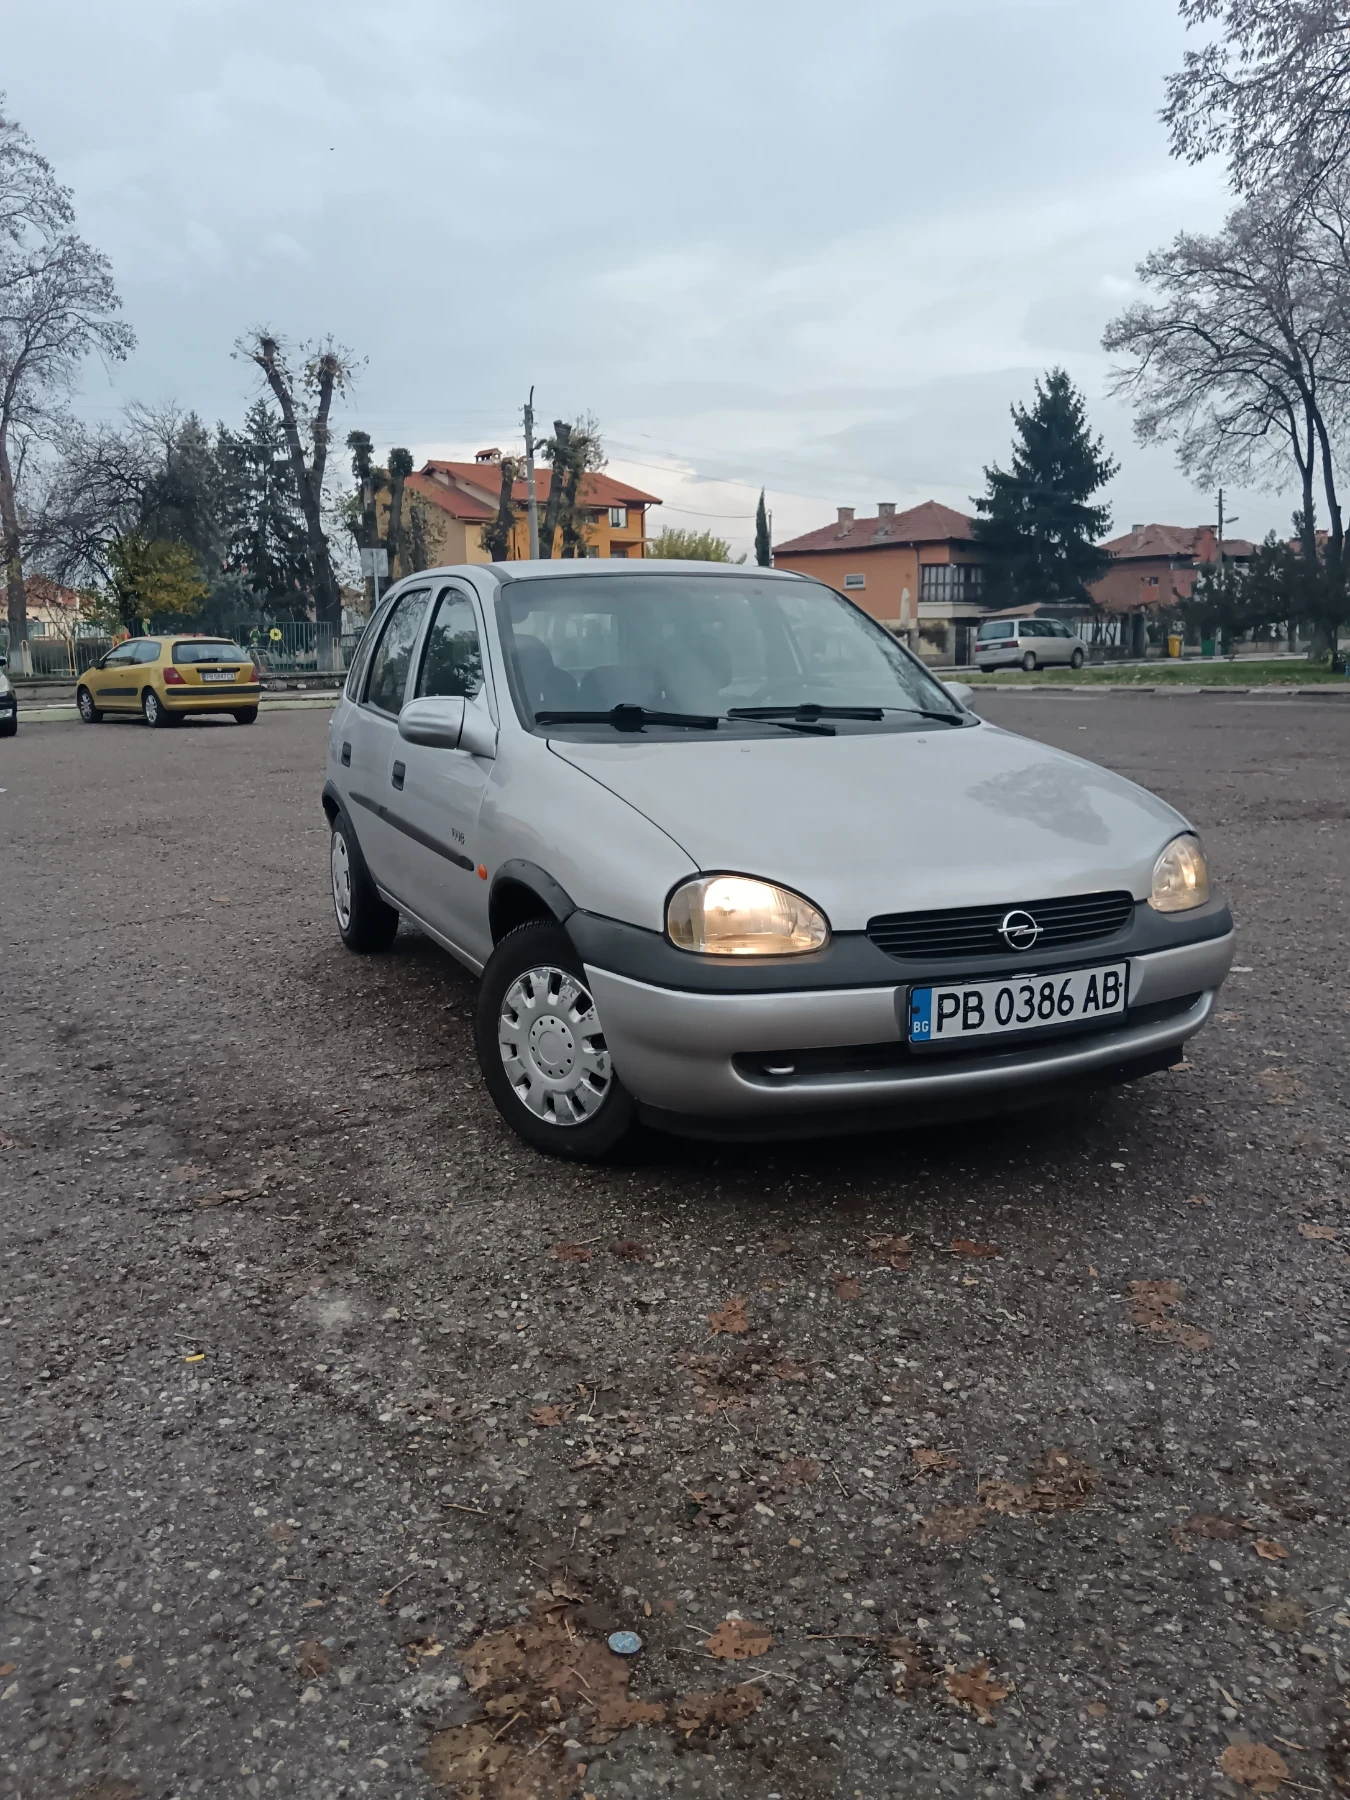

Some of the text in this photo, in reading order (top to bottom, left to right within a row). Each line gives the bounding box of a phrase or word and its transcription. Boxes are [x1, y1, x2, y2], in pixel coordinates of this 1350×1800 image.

[936, 970, 1120, 1033] PB 0386 AB
[913, 1021, 929, 1033] BG
